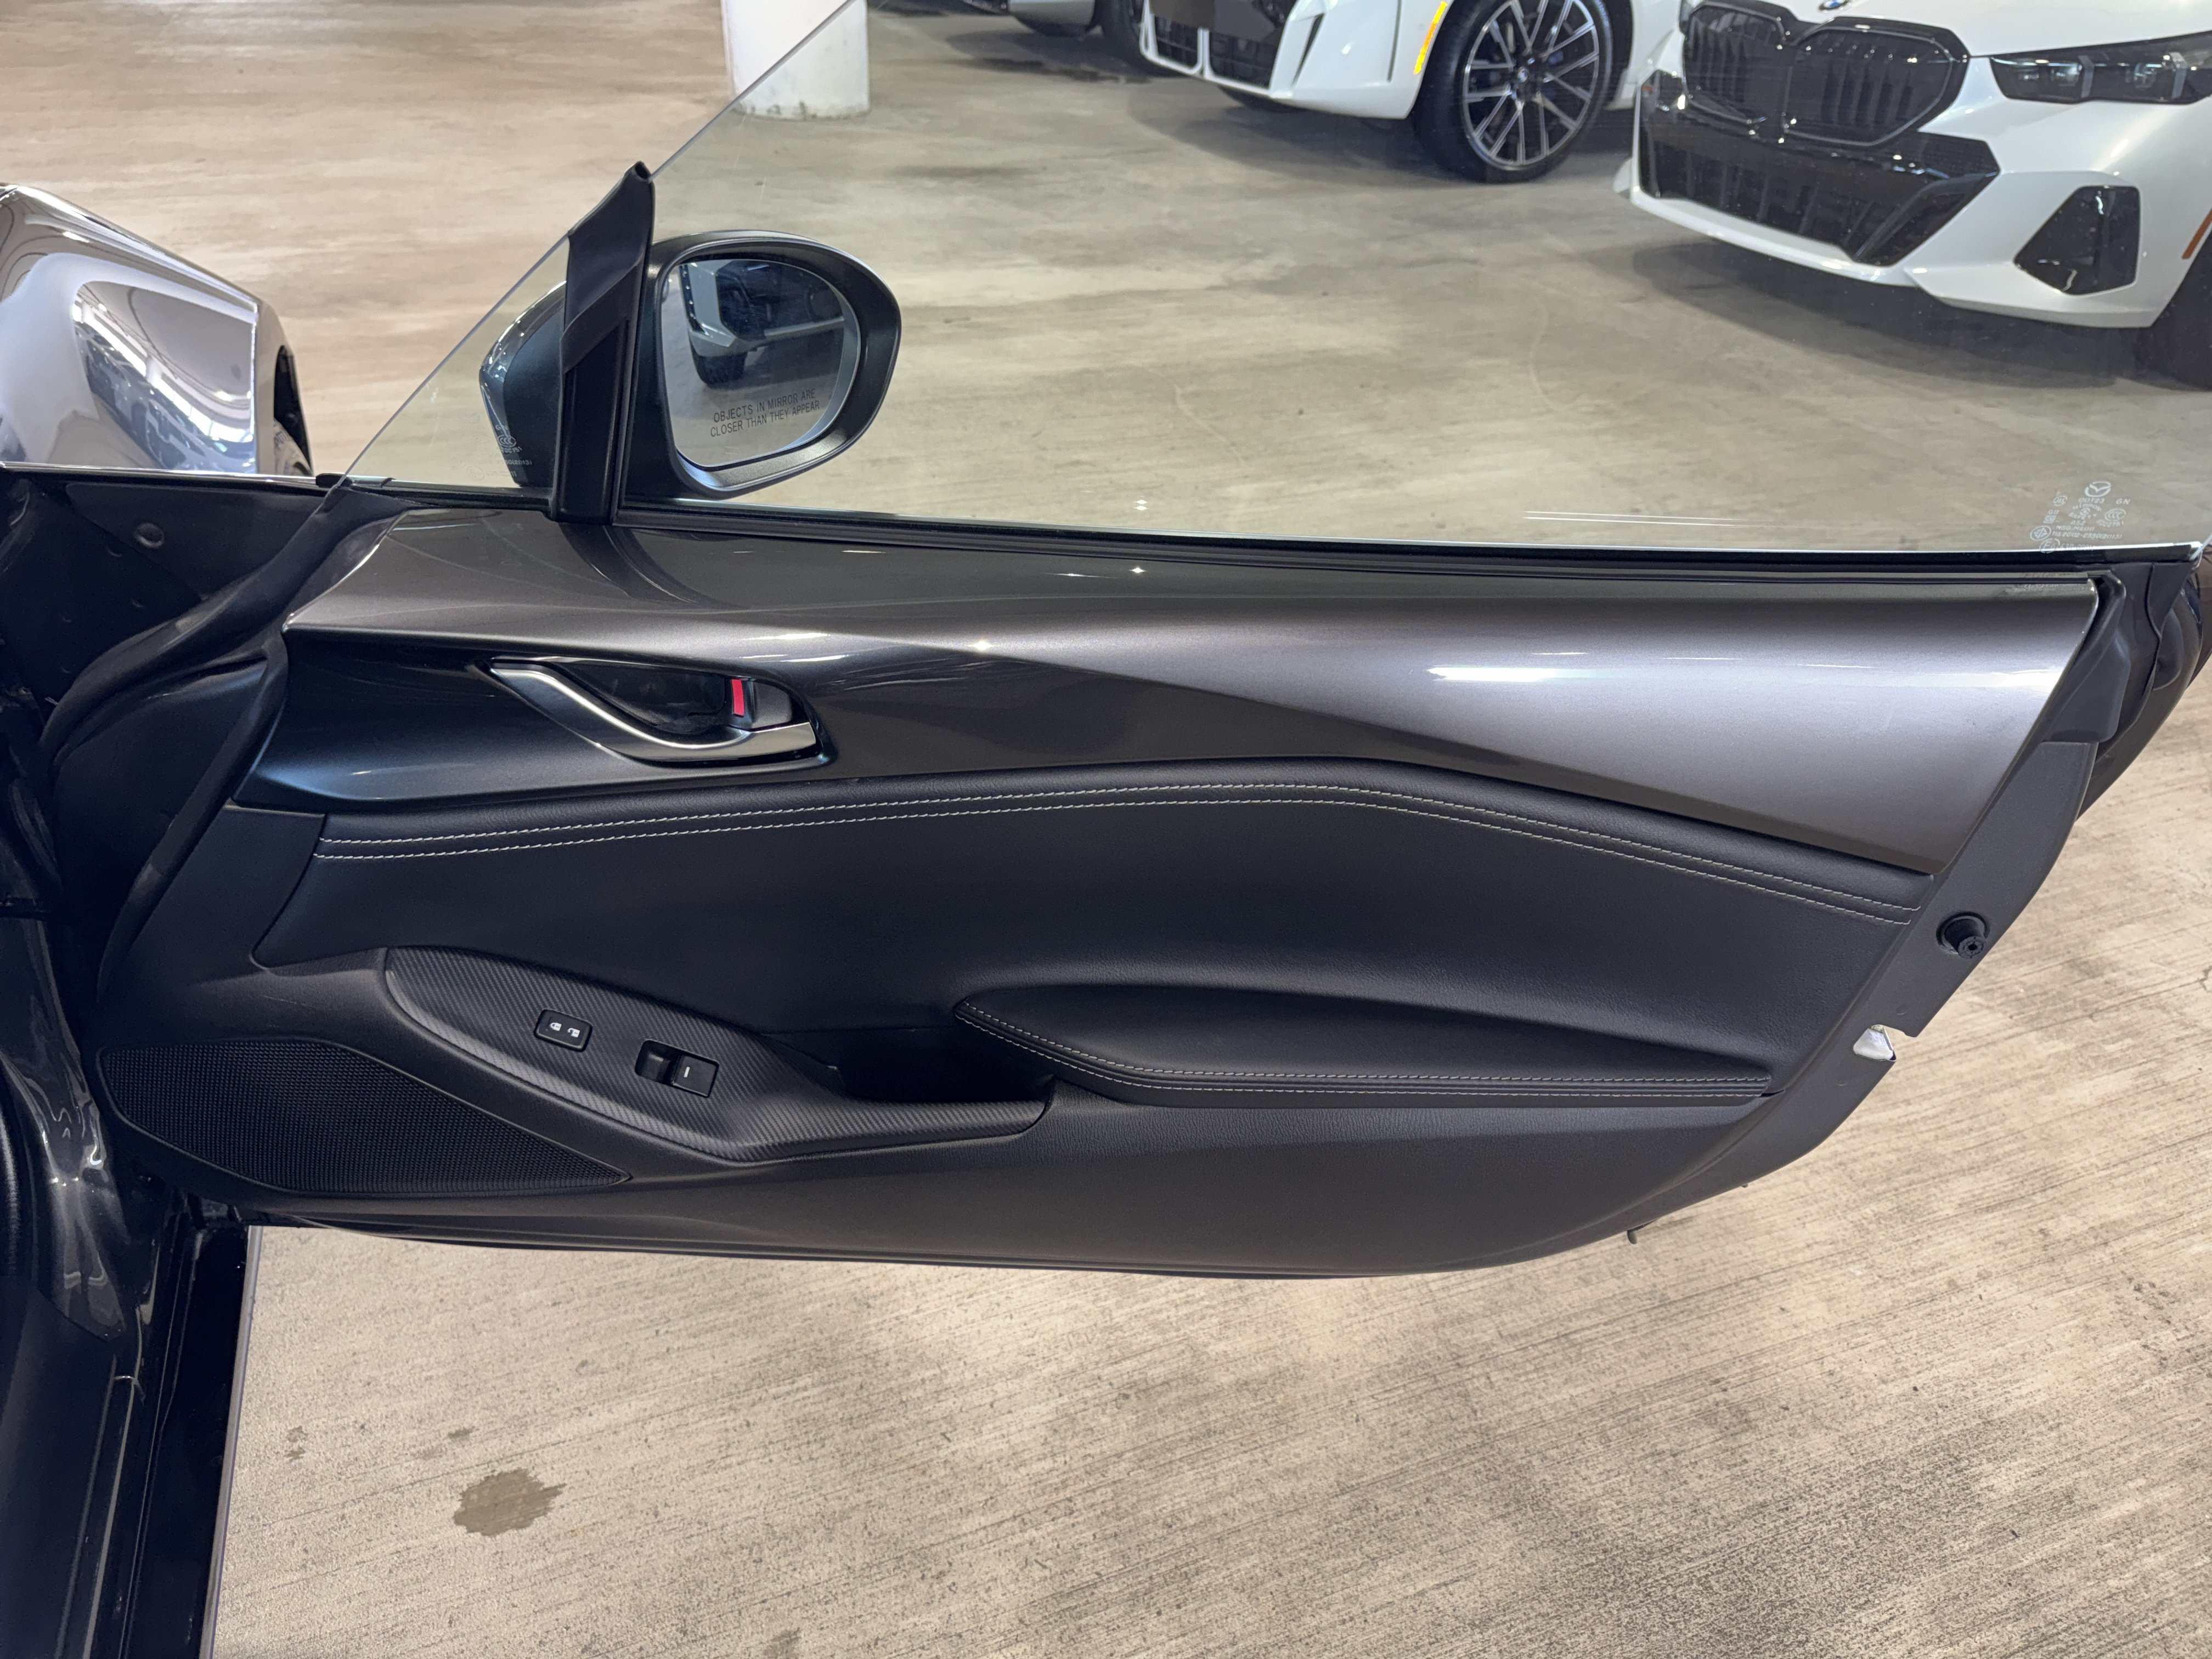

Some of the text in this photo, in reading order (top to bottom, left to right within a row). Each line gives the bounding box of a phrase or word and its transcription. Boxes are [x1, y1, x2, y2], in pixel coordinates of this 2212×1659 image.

[710, 400, 820, 437] CLOSER THAN THEY APPEAR
[714, 388, 816, 422] OBJECTS IN MIRROR ARE
